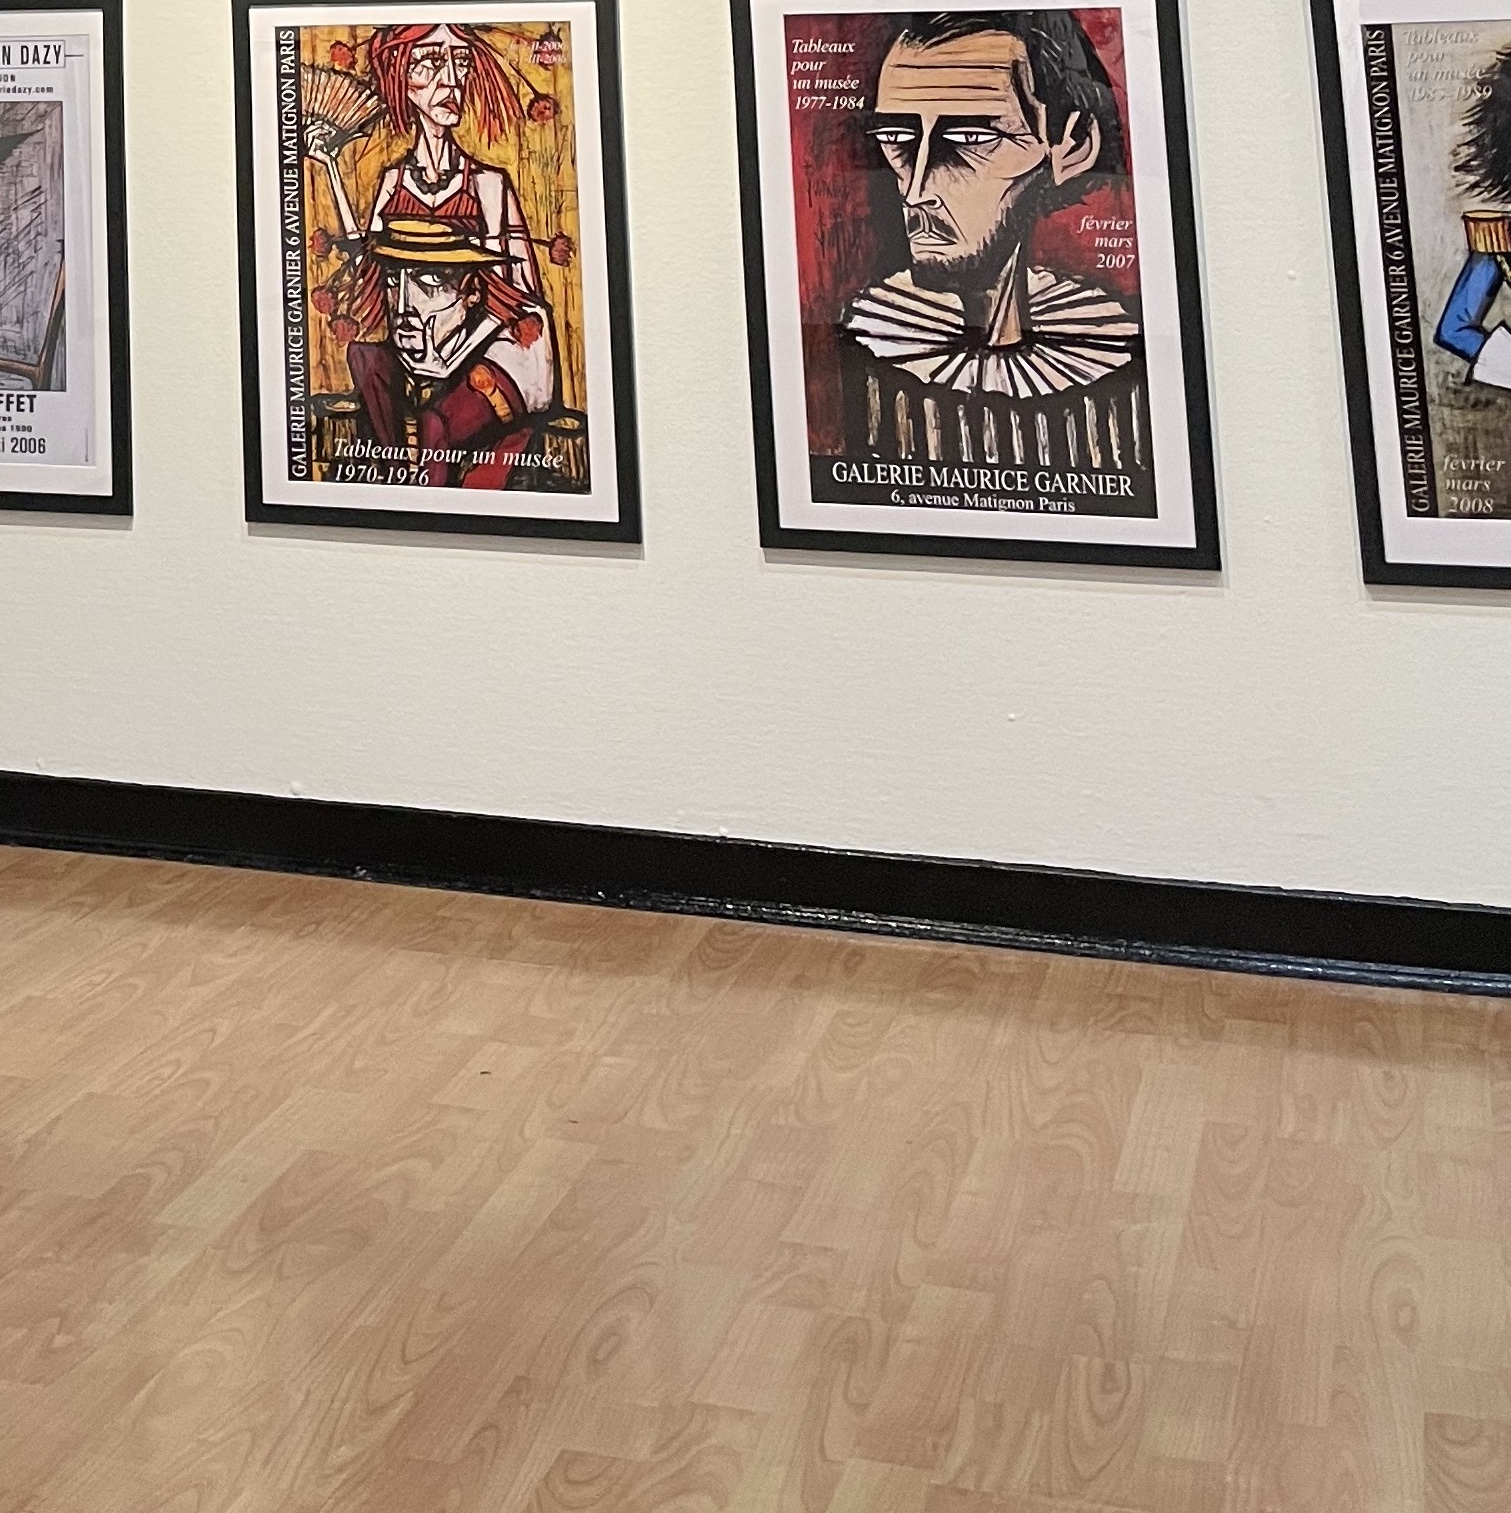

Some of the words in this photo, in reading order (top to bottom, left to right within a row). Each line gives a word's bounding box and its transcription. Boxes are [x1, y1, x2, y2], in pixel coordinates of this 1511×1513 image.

[792, 39, 855, 53] Tableaux
[1404, 29, 1480, 45] Tableaux
[20, 44, 62, 65] DAZY
[280, 30, 296, 74] PARIS
[1368, 29, 1388, 76] PARIS
[1408, 52, 1446, 67] pour
[790, 60, 826, 74] pour
[1408, 70, 1428, 82] un
[793, 80, 810, 90] un
[814, 75, 860, 90] musée
[795, 96, 864, 110] 1977-1984
[282, 78, 298, 164] MATIGNON
[1370, 80, 1396, 174] MATIGNON
[284, 169, 300, 233] AVENUE
[1378, 178, 1403, 248] AVENUE
[1076, 215, 1133, 234] février
[285, 236, 300, 248] 6
[1094, 237, 1133, 248] mars
[1096, 254, 1136, 268] 2007
[1386, 250, 1405, 261] 6
[286, 250, 303, 322] GARNIER
[1389, 264, 1414, 344] GARNIER
[288, 326, 304, 402] MAURICE
[1397, 346, 1422, 431] MAURICE
[10, 437, 46, 454] 2006
[290, 406, 307, 478] GALERIE
[334, 438, 412, 460] Tableaux
[420, 450, 466, 466] pour
[472, 451, 495, 465] un
[503, 448, 564, 469] musée
[335, 464, 429, 486] 1970-1976
[832, 461, 925, 486] GALERIE
[930, 466, 1029, 493] MAURICE
[1034, 471, 1135, 497] GARNIER
[1404, 433, 1430, 513] GALERIE
[1446, 480, 1491, 490] mars
[890, 490, 905, 505] 6,
[909, 494, 959, 507] avenue
[964, 492, 1034, 512] Matignon
[1039, 498, 1076, 512] Paris
[1448, 496, 1494, 514] 2008
